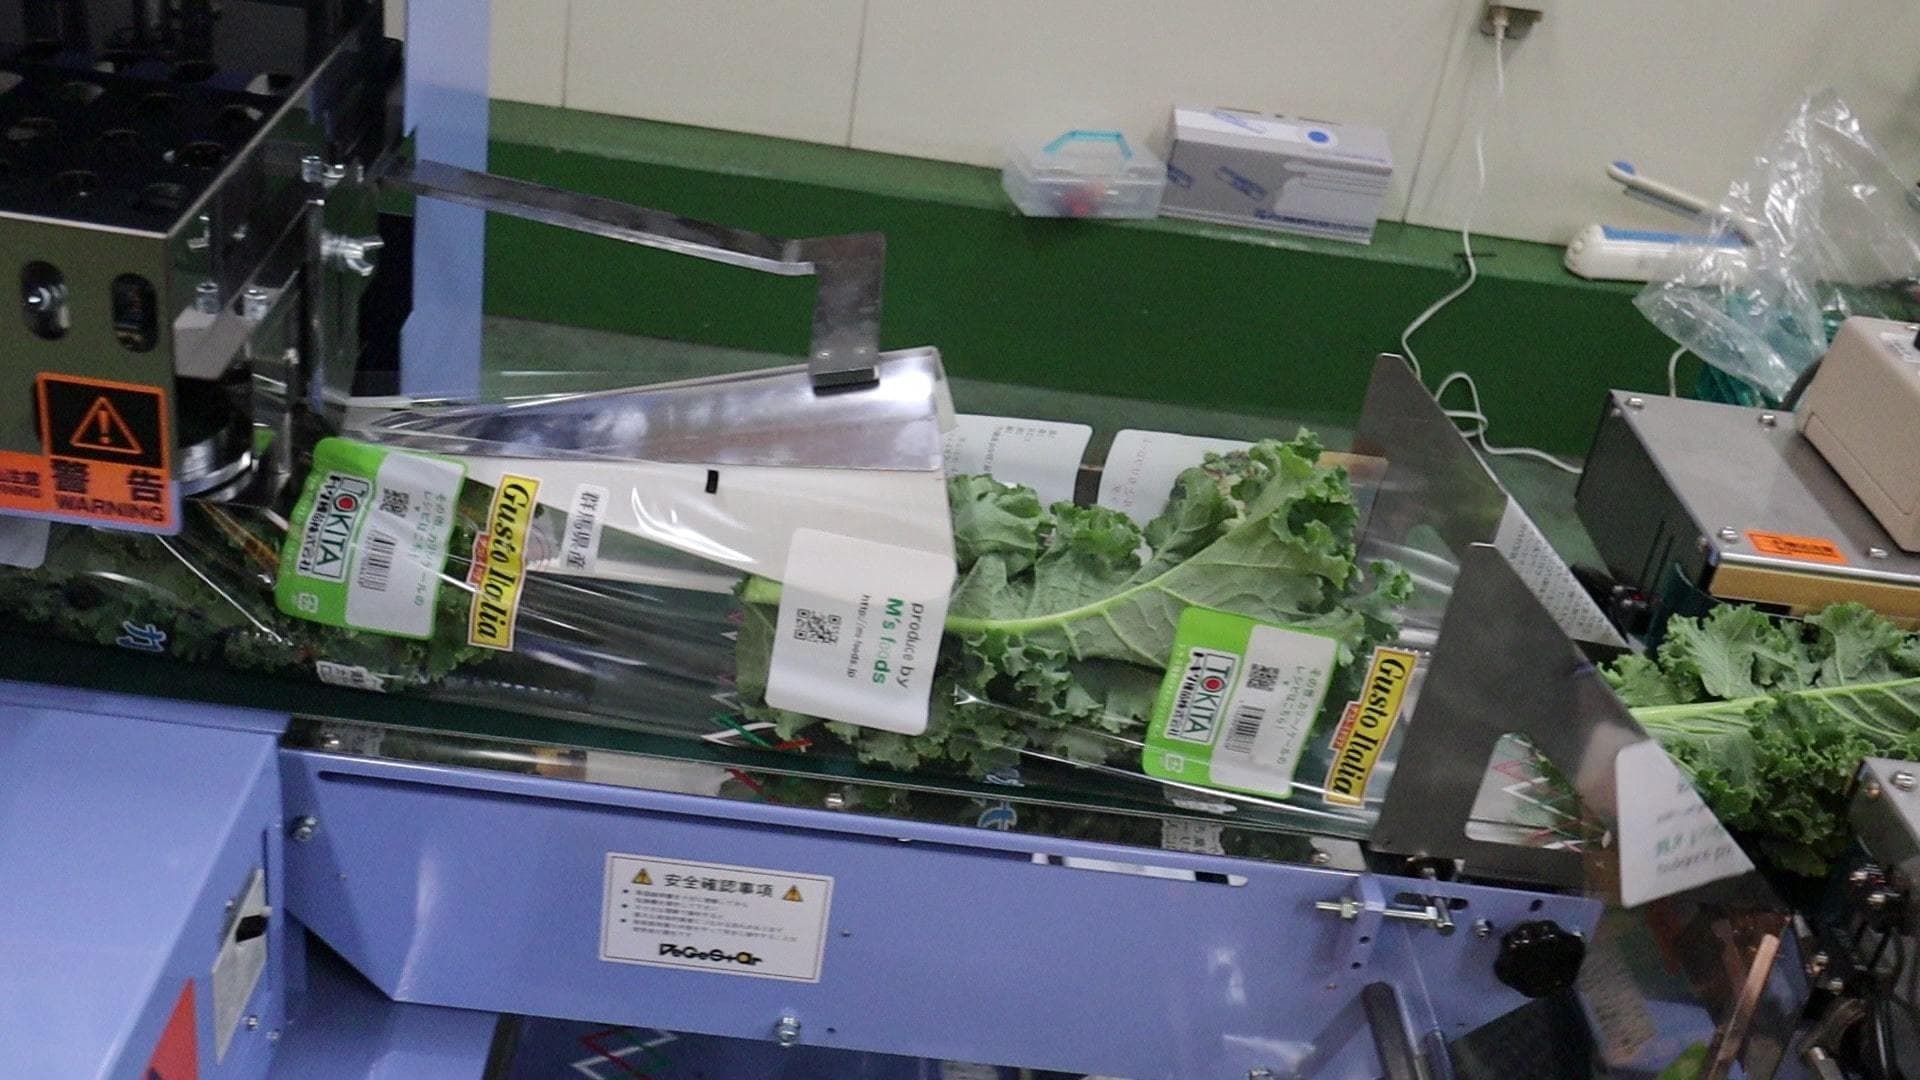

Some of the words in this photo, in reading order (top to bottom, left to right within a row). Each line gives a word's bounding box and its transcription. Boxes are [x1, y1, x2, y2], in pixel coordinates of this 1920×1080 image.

[56, 494, 165, 522] WARNING
[316, 483, 367, 567] TOKITA
[494, 482, 530, 561] Gusto
[566, 491, 600, 569] 群馬県産
[478, 570, 516, 640] Italia
[902, 603, 925, 661] produce
[896, 664, 915, 688] by
[1190, 665, 1232, 735] TOKITA
[1362, 658, 1406, 729] Gusto
[1333, 734, 1379, 795] Italia
[664, 873, 774, 898] 安全確認事項
